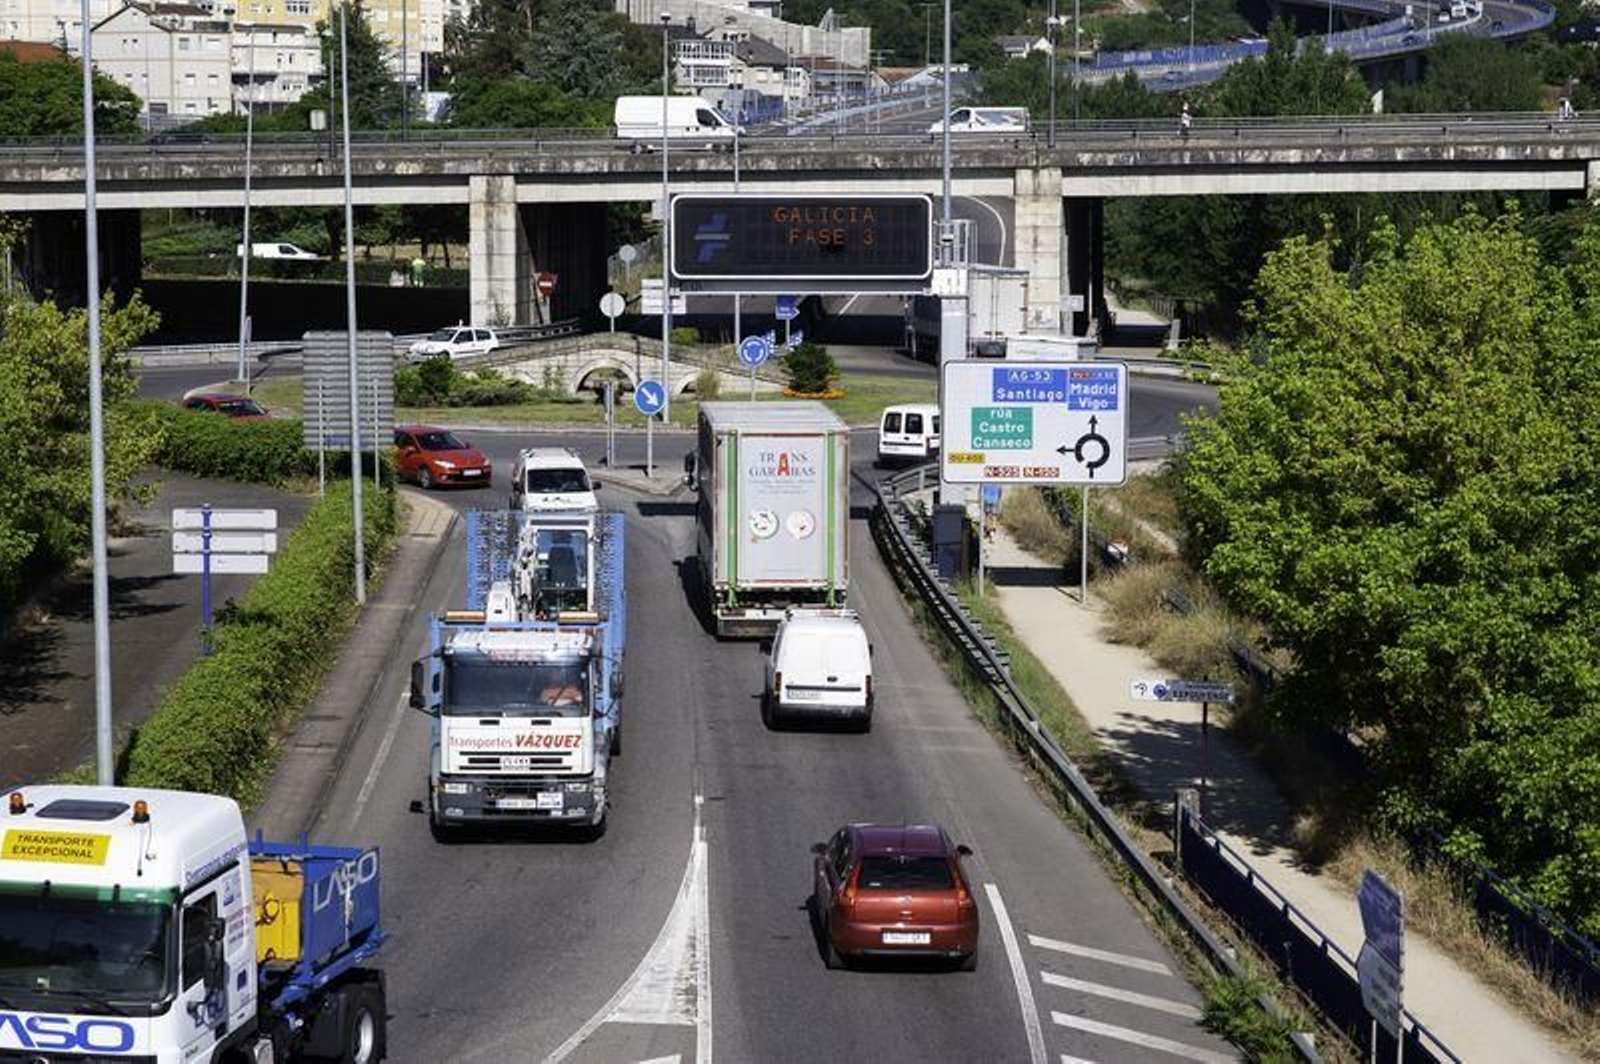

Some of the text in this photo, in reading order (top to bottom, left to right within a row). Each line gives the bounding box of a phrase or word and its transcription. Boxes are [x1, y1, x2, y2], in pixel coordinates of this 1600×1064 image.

[773, 206, 876, 224] GALICIA
[789, 228, 875, 246] FASE 3
[996, 387, 1064, 402] Santiago
[1070, 382, 1117, 396] Madrid
[1079, 398, 1109, 410] Vigo
[990, 406, 1012, 418] rúa
[978, 421, 1025, 434] Castro
[972, 436, 1031, 448] Canseco
[449, 731, 582, 750] Transportes VÁZQUEZ
[16, 833, 95, 847] TRANSPORTE
[11, 845, 95, 860] EXCEPCIONAL
[313, 850, 378, 912] LASO
[0, 1013, 135, 1053] ASO
